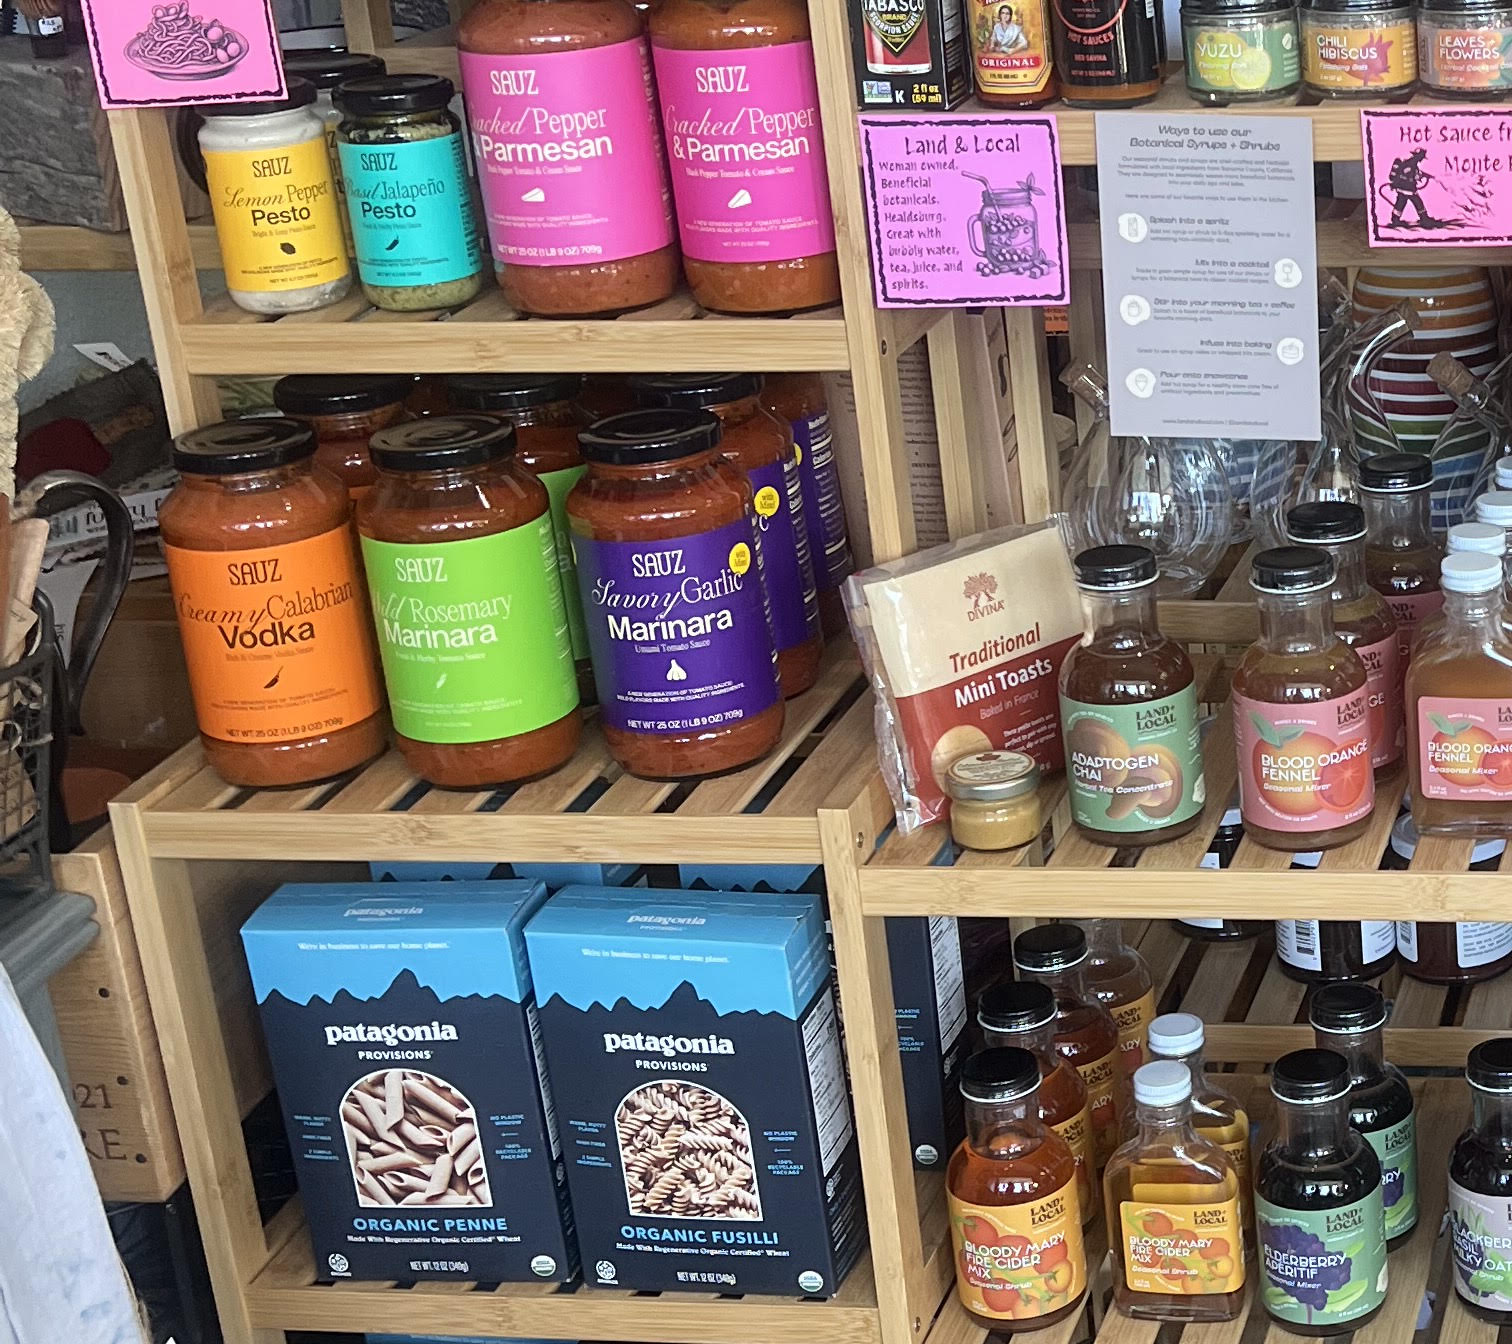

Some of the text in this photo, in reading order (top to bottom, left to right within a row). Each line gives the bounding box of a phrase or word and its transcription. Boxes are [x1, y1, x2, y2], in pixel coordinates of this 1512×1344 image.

[1197, 42, 1243, 59] YUZU
[1315, 34, 1348, 48] CHILI
[1438, 35, 1486, 48] LEAVES
[1317, 46, 1378, 60] HIBISCUS
[1438, 46, 1500, 60] FLOWERS
[694, 65, 750, 94] SAUZ
[665, 105, 815, 137] Cracked Pepper
[1158, 125, 1191, 137] Ways
[1192, 126, 1206, 137] to
[1231, 128, 1253, 137] our
[904, 133, 1021, 156] Land & Local
[1129, 137, 1228, 151] Botanical Syrups
[1399, 125, 1432, 143] Hot
[672, 135, 810, 163] & Parmesan
[252, 155, 293, 179] SAUZ
[878, 159, 959, 172] Woman owned.
[1445, 155, 1502, 173] Monte
[379, 177, 446, 203] Jalapeño
[881, 176, 932, 189] Beneficial
[223, 181, 330, 209] Lemon Pepper
[252, 206, 312, 227] Pesto
[632, 549, 686, 578] SAUZ
[591, 570, 744, 621] Savory Garlic
[179, 581, 354, 635] Creamy Calabrian
[410, 594, 513, 624] Rosemary
[218, 620, 316, 651] Vodka
[607, 609, 734, 643] Marinara
[949, 622, 1042, 674] Traditional
[954, 657, 1054, 709] Mini Toasts
[1135, 706, 1171, 722] LAND
[1136, 713, 1178, 732] LOCAL
[1070, 752, 1161, 772] ADAPTOGEN
[1260, 738, 1370, 769] BLOOD ORANGE
[1073, 764, 1103, 782] CHAI
[1260, 765, 1322, 783] FENNEL
[324, 1020, 459, 1047] patagonia
[357, 1049, 434, 1061] PROVISIONS
[352, 1217, 509, 1233] ORGANIC PENNE
[620, 1224, 780, 1247] ORGANIC FUSILLI
[965, 1229, 1067, 1259] BLOODY MARY
[966, 1253, 1042, 1271] FIRE CIDER
[1263, 1242, 1348, 1269] ELDERBERRY
